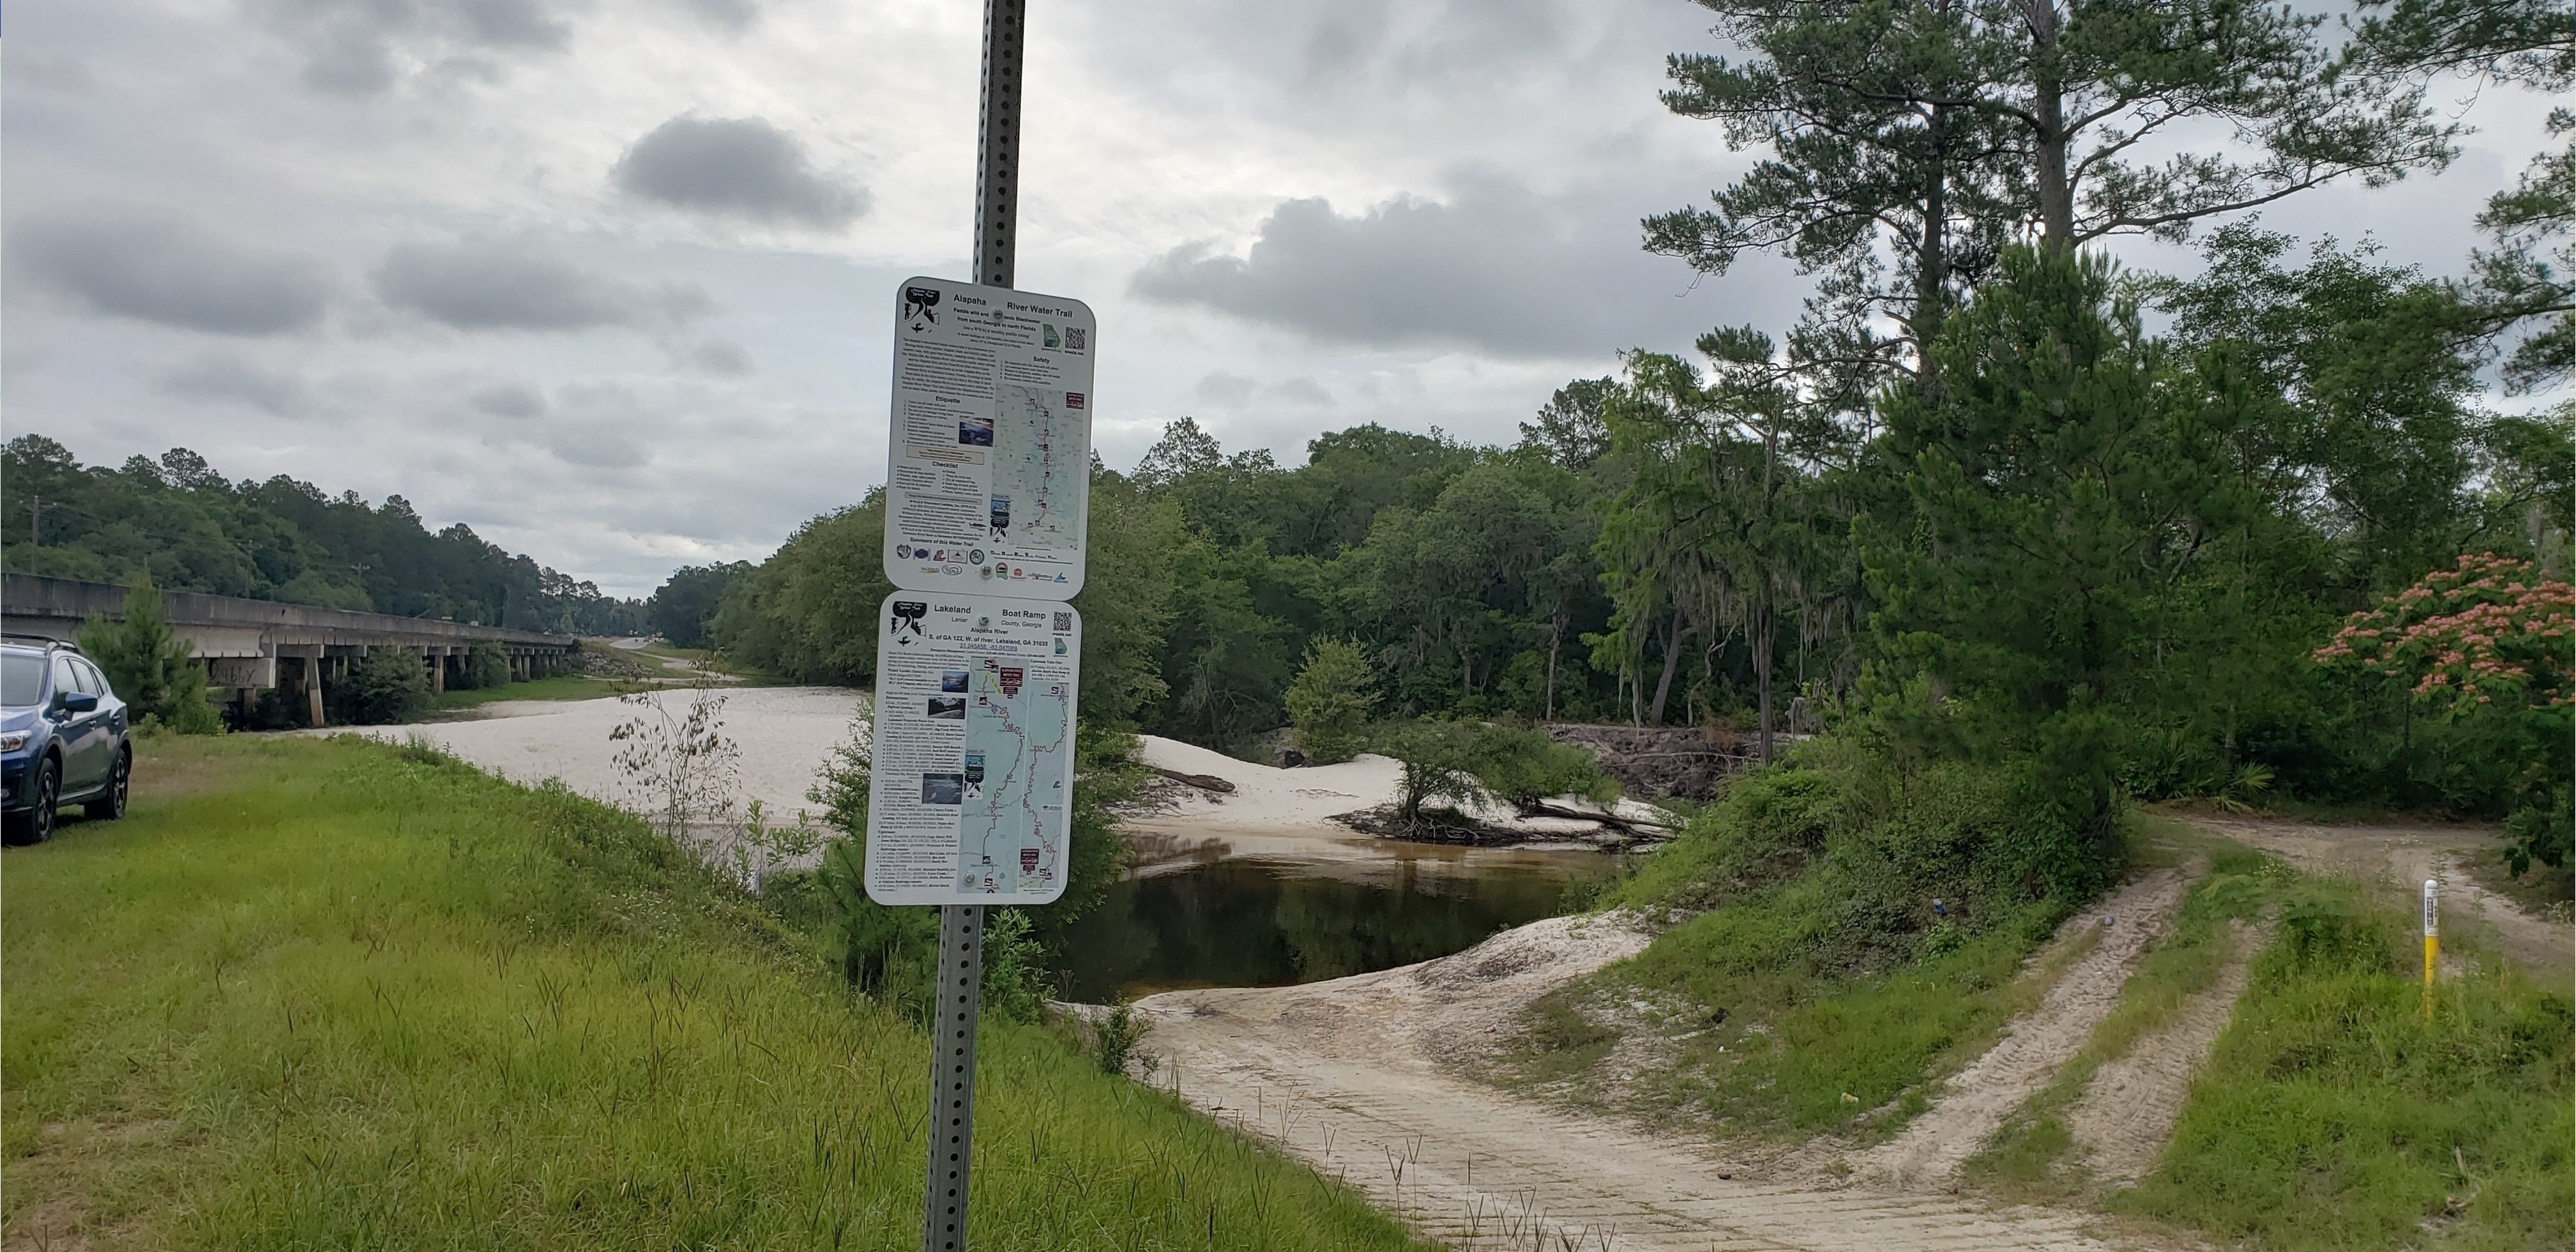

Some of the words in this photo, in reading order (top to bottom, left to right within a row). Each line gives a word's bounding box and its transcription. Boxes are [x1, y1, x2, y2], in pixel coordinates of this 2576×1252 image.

[953, 294, 987, 307] Alapaha
[1007, 302, 1028, 312] River
[1029, 304, 1052, 316] Water
[1055, 308, 1072, 318] Trail
[983, 319, 1001, 328] Georgia
[1033, 356, 1050, 365] Safety
[936, 395, 960, 404] Etiquette
[932, 461, 958, 470] Checklist
[934, 604, 971, 614] Lakeland
[1002, 609, 1021, 618] Boat
[1022, 611, 1046, 620] Ramp
